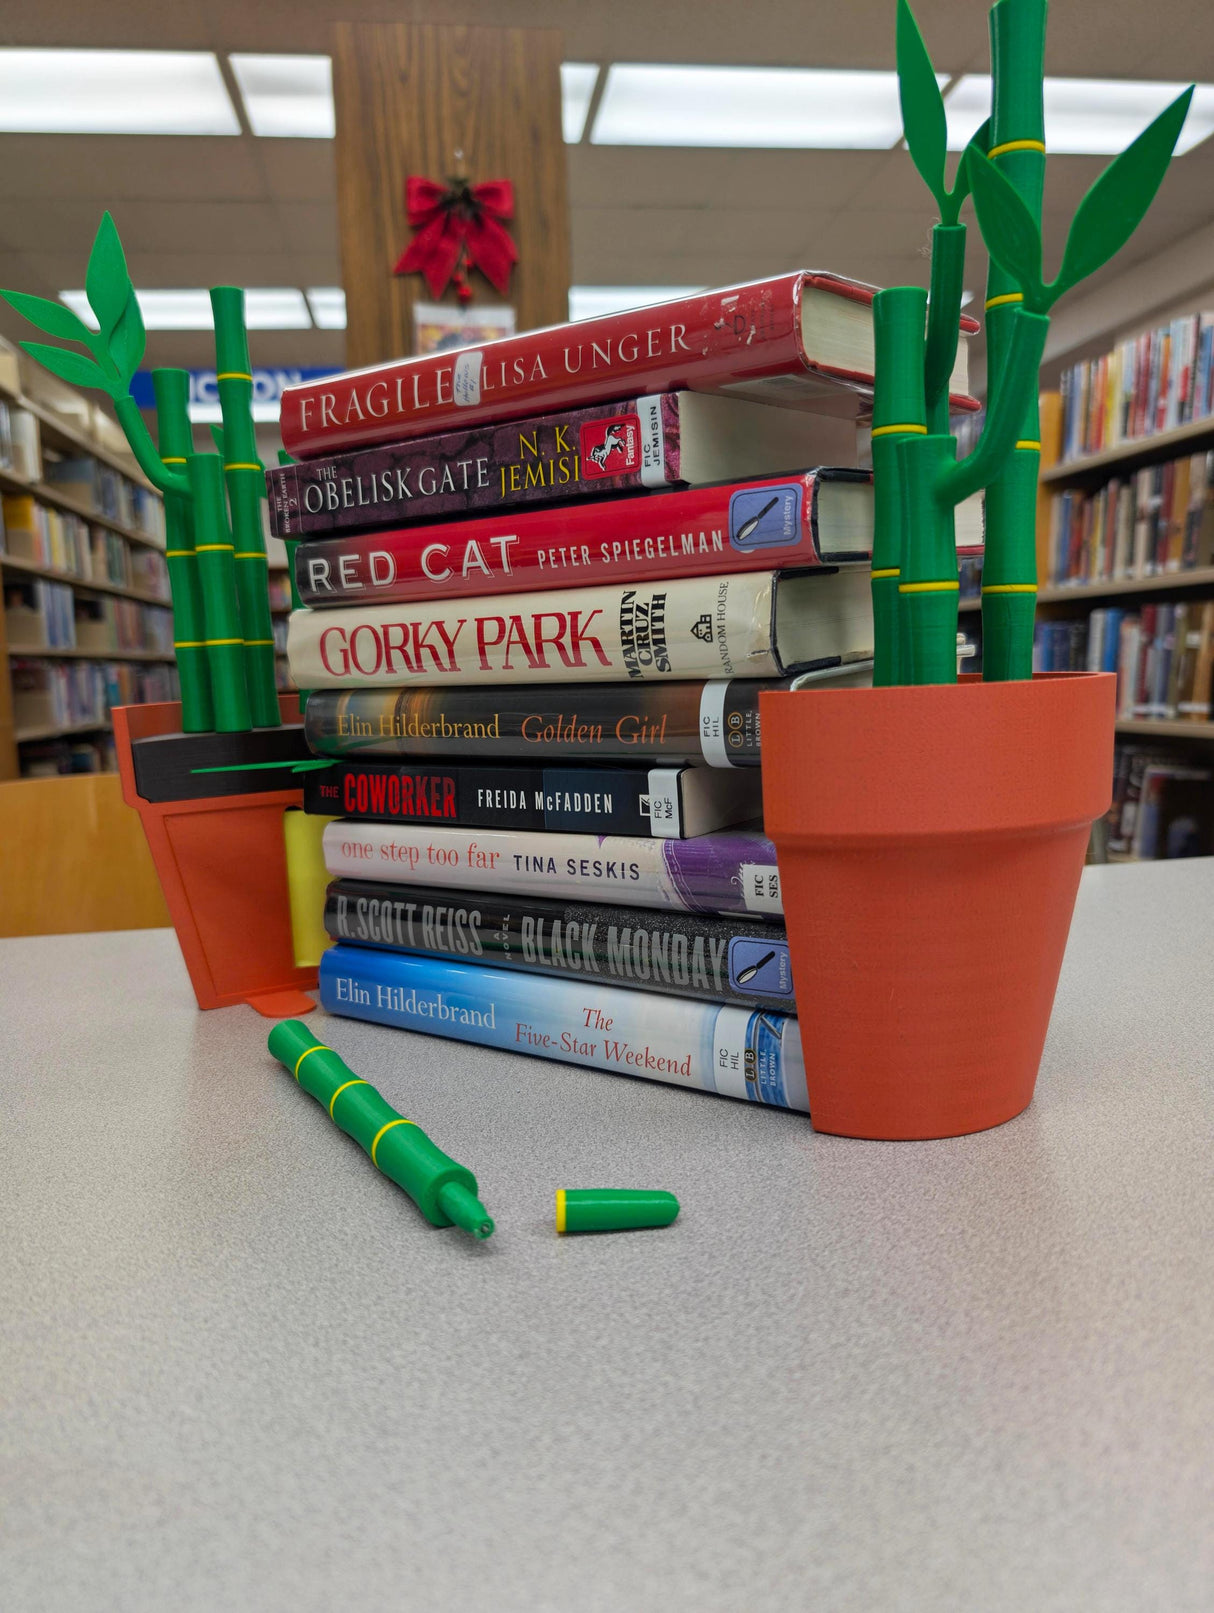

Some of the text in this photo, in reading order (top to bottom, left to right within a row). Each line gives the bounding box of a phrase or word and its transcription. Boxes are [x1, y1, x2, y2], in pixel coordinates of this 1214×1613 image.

[300, 324, 691, 432] FRAGILE LISA UNGER
[519, 424, 576, 459] N. K.
[625, 424, 636, 466] Fantasy
[650, 405, 660, 465] JEMISIN
[316, 466, 338, 482] THE
[643, 443, 651, 467] FIC
[280, 473, 288, 499] EARTH
[304, 457, 490, 513] OBELISK GATE
[501, 455, 580, 498] JEMISI
[289, 498, 298, 507] 2
[783, 495, 792, 536] Mystery
[308, 534, 520, 594] RED CAT
[537, 529, 724, 569] PETER SPIEGELMAN
[319, 609, 612, 677] GORKY PARK
[620, 590, 645, 679] MARTIN
[634, 602, 654, 666] CRUZ
[650, 592, 672, 673] SMITH
[717, 581, 735, 674] RANDOM HOUSE
[336, 713, 501, 739] Elin Hilderbrand
[521, 713, 667, 744] Golden Girl
[320, 773, 457, 818] THE COWORKER
[477, 788, 613, 814] FREIDA McFADDEN
[653, 800, 662, 819] FIC
[664, 797, 673, 819] McF
[341, 840, 500, 871] one step too far
[513, 854, 640, 881] TINA SESKIS
[755, 874, 764, 896] FIC
[769, 874, 778, 898] SES
[337, 895, 484, 957] R. SCOTT REISS
[502, 914, 512, 960] NOVEL
[521, 915, 728, 992] BLACK MONDAY
[779, 951, 788, 990] Mystery
[335, 977, 496, 1029] Elin Hilderbrand
[582, 1007, 614, 1032] The
[515, 1022, 692, 1077] Five-Star Weekend
[719, 1048, 728, 1068] FIC
[730, 1051, 739, 1070] HIL
[769, 1052, 777, 1087] BROWN
